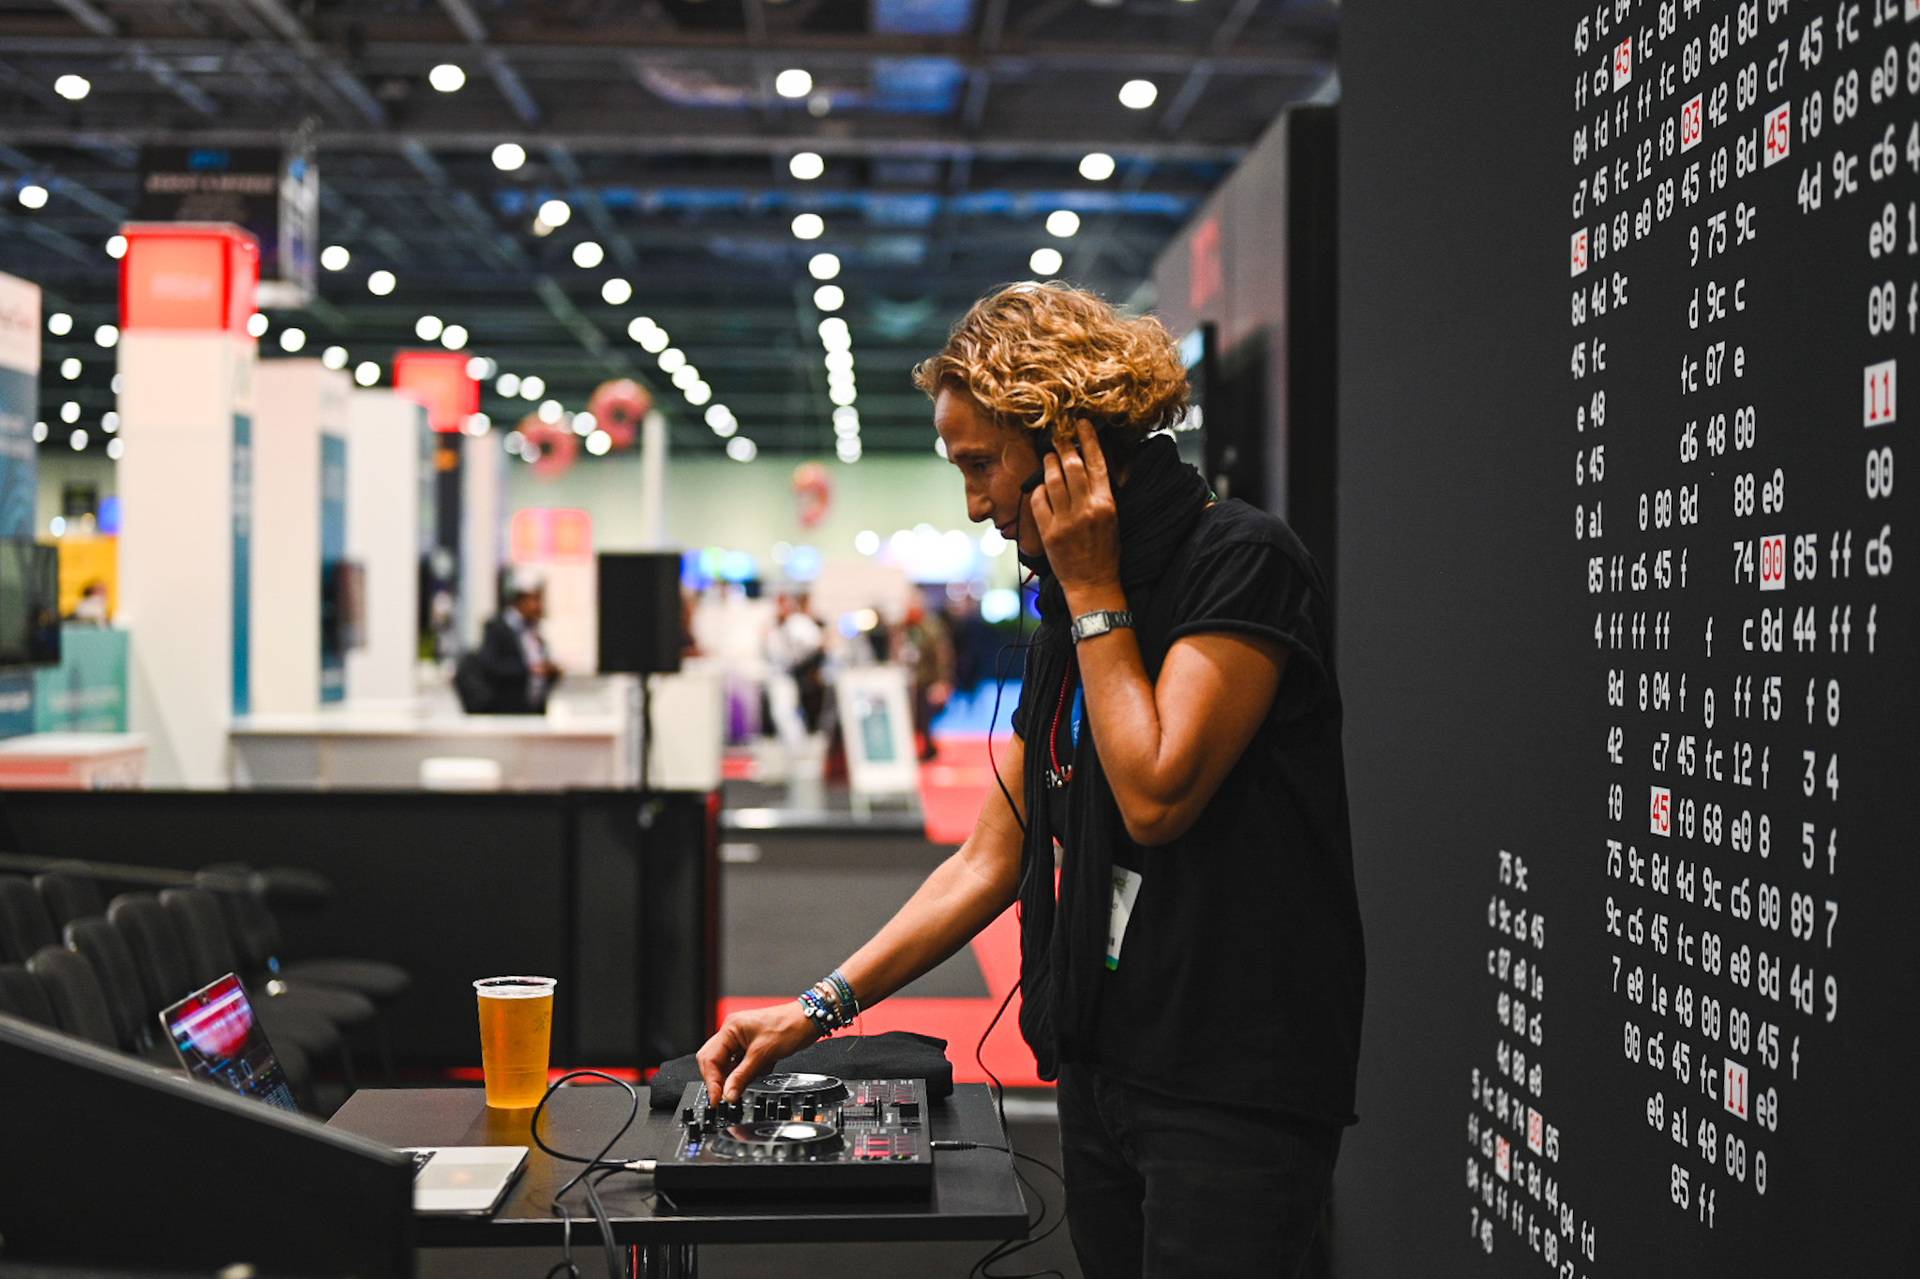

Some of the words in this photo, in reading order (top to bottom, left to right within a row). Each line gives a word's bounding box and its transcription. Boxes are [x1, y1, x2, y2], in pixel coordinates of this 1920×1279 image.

[1574, 15, 1590, 57] 45
[1595, 4, 1610, 41] fc
[1658, 0, 1676, 41] 8d
[1574, 71, 1588, 112] ff
[1593, 54, 1609, 97] c6
[1637, 25, 1654, 64] fc
[1594, 109, 1609, 152] fd
[1615, 95, 1629, 138] ff
[1637, 78, 1652, 123] ff
[1659, 61, 1676, 101] fc
[1682, 36, 1702, 84] 00
[1709, 14, 1729, 66] 8d
[1737, 0, 1759, 46] 8d
[1572, 178, 1588, 220] c7
[1592, 165, 1608, 207] 45
[1614, 157, 1629, 195] fc
[1636, 138, 1652, 183] 12
[1658, 116, 1675, 161] f8
[1708, 81, 1728, 129] 42
[1736, 61, 1758, 113] 00
[1766, 38, 1789, 93] c7
[1799, 15, 1823, 71] 45
[1836, 1, 1860, 50] fc
[1612, 210, 1629, 252] 68
[1656, 177, 1675, 222] 89
[1681, 161, 1700, 208] 45
[1709, 146, 1728, 194] f0
[1735, 127, 1757, 179] 8d
[1800, 90, 1823, 144] f0
[1833, 68, 1859, 125] 68
[1870, 45, 1898, 104] e0
[1797, 161, 1822, 214] 4d
[1832, 150, 1858, 200] 9c
[1869, 123, 1897, 182] c6
[1707, 210, 1727, 259] 75
[1735, 201, 1756, 246] 9c
[1869, 202, 1897, 259] e8
[1571, 287, 1587, 327] 8d
[1591, 277, 1607, 317] 4d
[1612, 271, 1628, 309] 9c
[1706, 280, 1726, 323] 9c
[1868, 280, 1896, 336] 00
[1571, 341, 1586, 380] 45
[1591, 336, 1606, 373] fc
[1680, 354, 1698, 395] fc
[1705, 340, 1726, 387] 07
[1734, 346, 1745, 378] e
[1590, 389, 1606, 428] 48
[1679, 420, 1699, 464] d6
[1706, 413, 1727, 457] 48
[1734, 405, 1756, 451] 00
[1589, 444, 1605, 483] 45
[1866, 446, 1894, 499] 00
[1679, 483, 1699, 526] 8d
[1734, 472, 1755, 518] 88
[1761, 467, 1785, 514] e8
[1588, 501, 1603, 539] a1
[1588, 556, 1604, 594] 85
[1610, 555, 1624, 593] ff
[1630, 552, 1648, 591] c6
[1653, 549, 1672, 590] 45
[1733, 540, 1755, 585] 74
[1793, 533, 1818, 581] 85
[1830, 529, 1852, 579] ff
[1865, 524, 1893, 576] c6
[1609, 612, 1624, 649] ff
[1631, 611, 1646, 650] ff
[1654, 611, 1670, 650] ff
[1742, 618, 1754, 651] c
[1760, 607, 1783, 653] 8d
[1792, 606, 1817, 653] 44
[1829, 604, 1851, 653] ff
[1607, 668, 1624, 707] 8d
[1652, 671, 1671, 711] 04
[1734, 675, 1752, 719] ff
[1762, 676, 1782, 721] f5
[1826, 679, 1840, 727] 8
[1607, 726, 1624, 765] 42
[1652, 732, 1670, 772] c7
[1676, 735, 1696, 777] 45
[1705, 738, 1723, 782] fc
[1733, 741, 1753, 787] 12
[1608, 783, 1623, 822] f0
[1803, 750, 1816, 797] 3
[1826, 753, 1839, 801] 4
[1677, 798, 1696, 840] f0
[1702, 802, 1723, 846] 68
[1731, 810, 1752, 853] e0
[1759, 814, 1771, 859] 8
[1802, 822, 1815, 869] 5
[1606, 838, 1623, 879] 75
[1628, 846, 1645, 887] 9c
[1651, 852, 1669, 895] 8d
[1675, 859, 1695, 903] 4d
[1702, 866, 1722, 912] 9c
[1730, 877, 1752, 921] c6
[1758, 882, 1781, 931] 00
[1790, 891, 1814, 941] 89
[1825, 900, 1838, 948] 7
[1605, 896, 1622, 937] 9c
[1627, 907, 1644, 946] c6
[1650, 913, 1669, 955] 45
[1677, 922, 1694, 966] fc
[1701, 930, 1722, 976] 08
[1729, 944, 1751, 988] e8
[1757, 951, 1780, 1002] 8d
[1789, 964, 1814, 1015] 4d
[1824, 975, 1838, 1022] 9
[1627, 966, 1644, 1005] e8
[1651, 973, 1668, 1017] 1e
[1675, 984, 1694, 1028] 48
[1701, 995, 1721, 1041] 00
[1729, 1007, 1750, 1055] 00
[1757, 1021, 1780, 1070] 45
[1624, 1021, 1641, 1064] 00
[1647, 1031, 1665, 1071] c6
[1672, 1040, 1691, 1085] 45
[1699, 1054, 1718, 1101] fc
[1756, 1087, 1778, 1132] e8
[1545, 1123, 1560, 1163] 85
[1646, 1091, 1665, 1132] e8
[1671, 1106, 1689, 1148] a1
[1697, 1117, 1717, 1165] 48
[1725, 1133, 1746, 1183] 00
[1755, 1150, 1767, 1195] 0
[1670, 1163, 1690, 1210] 85
[1698, 1183, 1715, 1229] ff
[1580, 1220, 1595, 1262] fd
